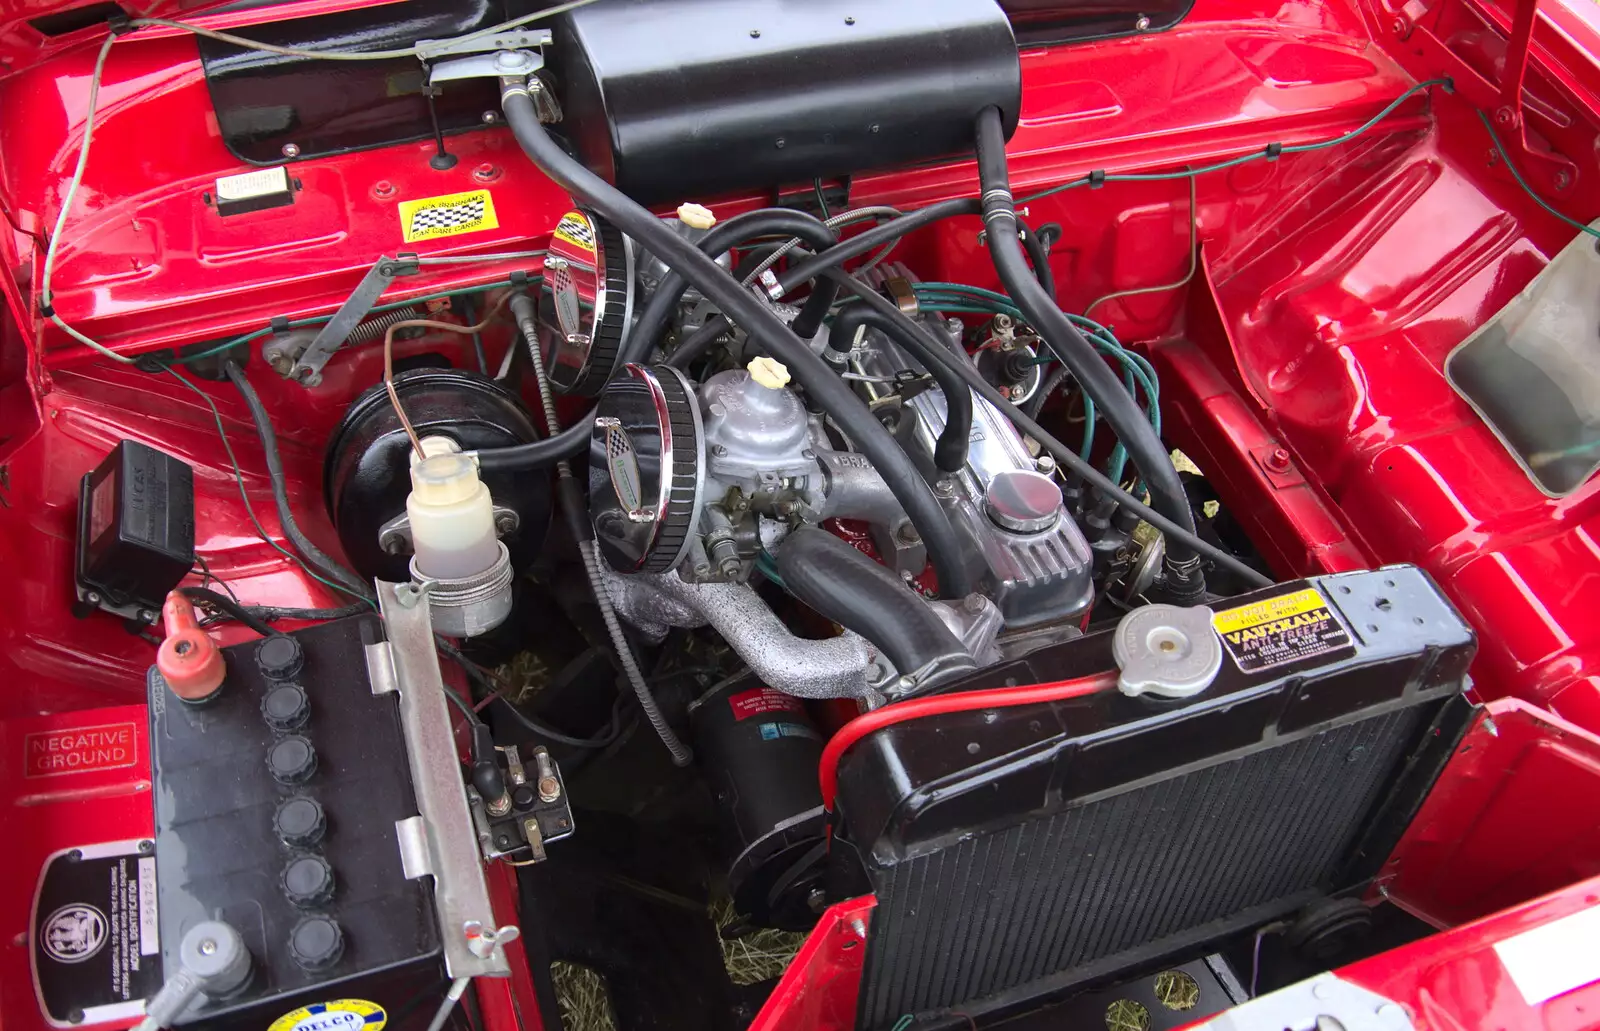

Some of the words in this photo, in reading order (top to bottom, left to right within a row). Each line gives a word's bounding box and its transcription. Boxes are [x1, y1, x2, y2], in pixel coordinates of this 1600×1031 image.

[1241, 613, 1269, 625] FILLED
[1277, 606, 1299, 616] WITH
[1243, 603, 1267, 617] NOT
[1270, 593, 1310, 609] DRAIN
[1226, 610, 1330, 644] VAUXHALL
[1243, 620, 1328, 652] ANTI-FREEZE
[33, 730, 129, 752] NEGATIVE
[37, 748, 126, 770] GROUND
[111, 901, 119, 913] THE
[128, 880, 139, 940] IDENTIFICATION
[112, 935, 119, 945] TO
[121, 929, 129, 957] NUMBERS
[112, 945, 120, 978] ESSENTIAL
[130, 941, 140, 971] MODEL
[122, 972, 130, 1000] LETTERS
[298, 1013, 354, 1031] DELCO
